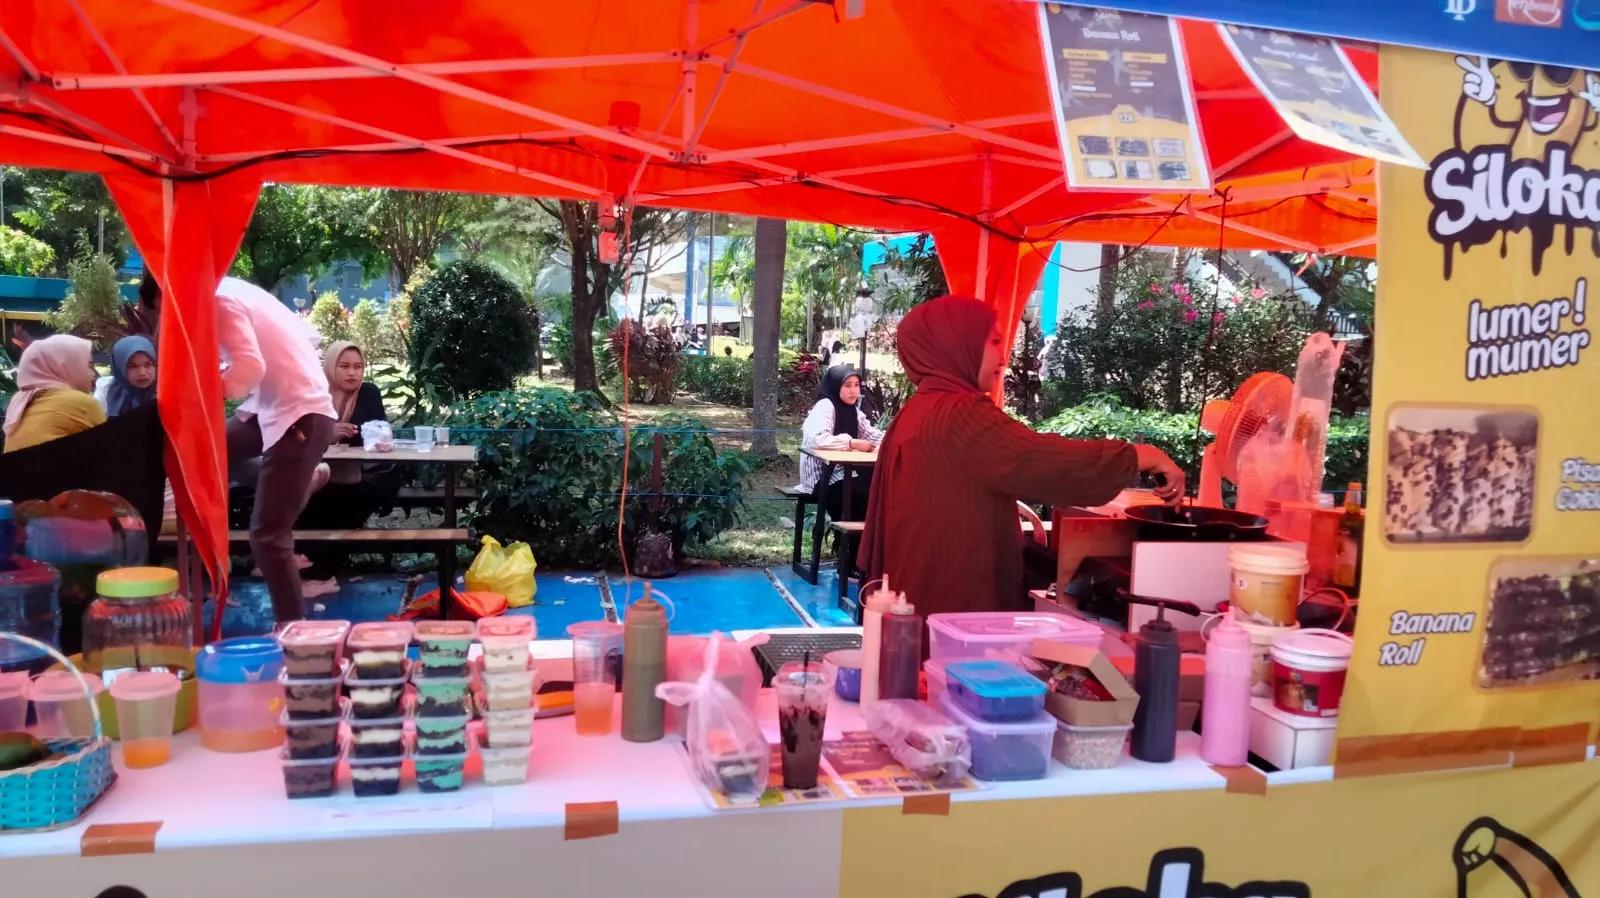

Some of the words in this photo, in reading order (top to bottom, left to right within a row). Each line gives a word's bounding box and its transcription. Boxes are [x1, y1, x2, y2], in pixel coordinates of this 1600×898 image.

[1467, 330, 1590, 380] mumer
[1390, 611, 1475, 635] Banana
[1379, 639, 1426, 666] Roll
